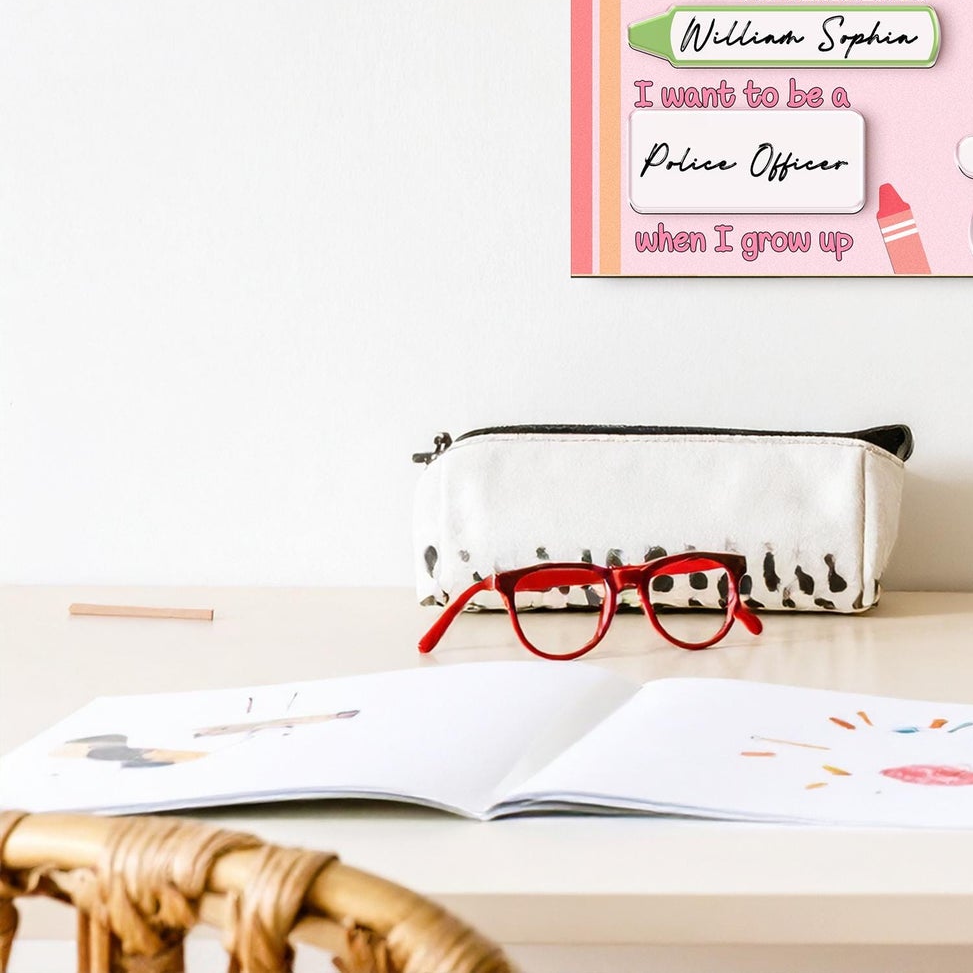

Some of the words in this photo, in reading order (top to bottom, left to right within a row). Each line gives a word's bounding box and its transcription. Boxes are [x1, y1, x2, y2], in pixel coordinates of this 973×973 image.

[680, 16, 805, 52] William
[818, 15, 919, 59] Sophia
[634, 80, 653, 108] I
[661, 80, 736, 108] want
[743, 80, 779, 108] to
[787, 78, 824, 108] be
[831, 86, 851, 108] a
[640, 142, 737, 178] Police
[750, 142, 849, 182] Officer
[634, 222, 706, 253] when
[714, 225, 733, 252] I
[741, 228, 811, 261] grow
[819, 230, 854, 261] up
